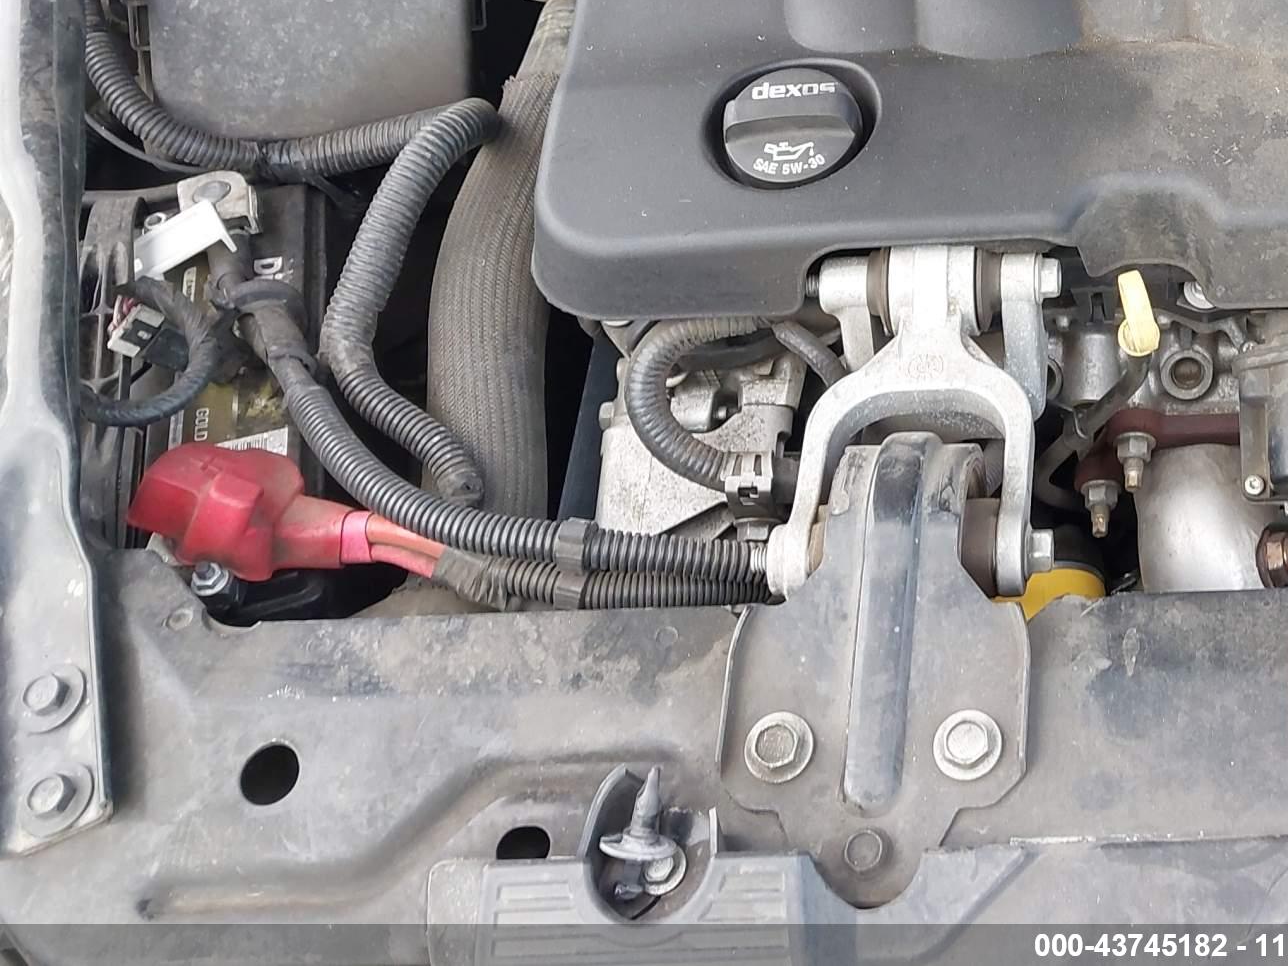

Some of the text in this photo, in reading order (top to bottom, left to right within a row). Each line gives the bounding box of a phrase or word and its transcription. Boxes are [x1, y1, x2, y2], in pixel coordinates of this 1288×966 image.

[751, 82, 836, 100] dexos
[753, 153, 826, 175] SAE 5W-30
[194, 407, 209, 442] GOLD
